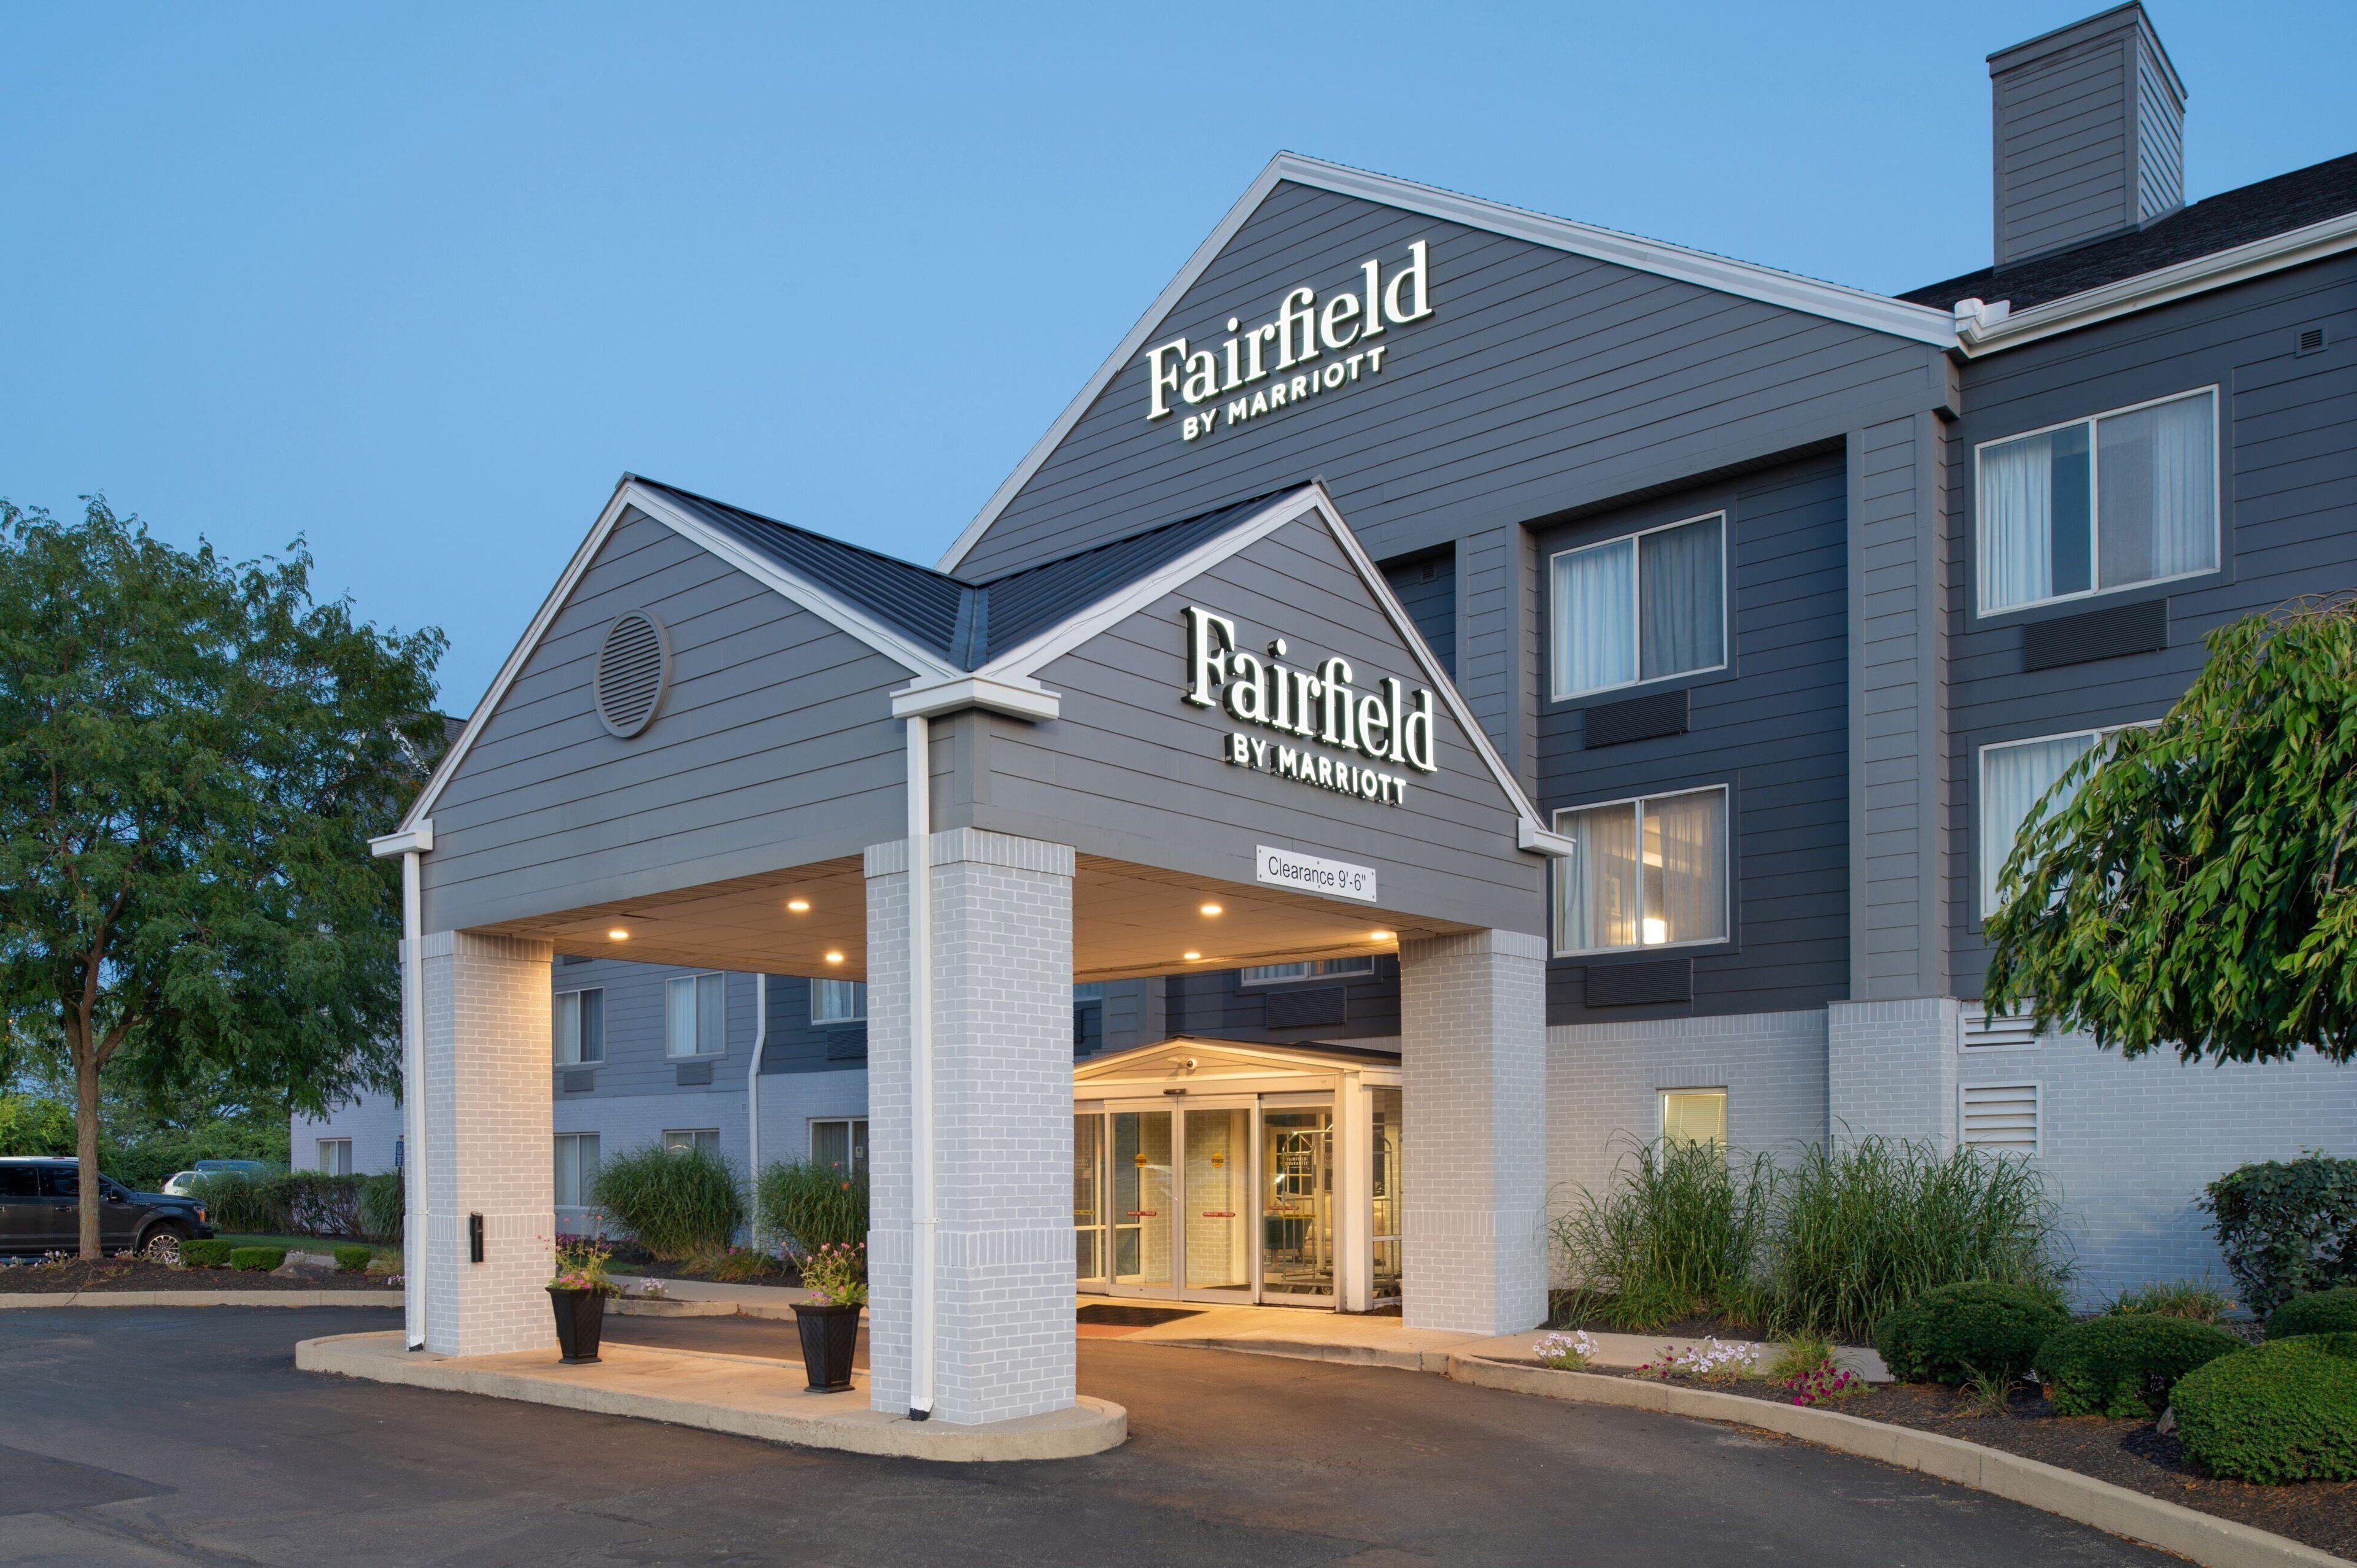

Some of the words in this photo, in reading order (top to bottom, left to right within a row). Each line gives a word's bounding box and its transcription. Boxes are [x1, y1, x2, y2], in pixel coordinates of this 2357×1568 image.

[1145, 240, 1435, 420] Fairfield
[1183, 407, 1220, 442] BY
[1228, 346, 1388, 426] MARRIOTT
[1181, 606, 1438, 773] Fairfield
[1225, 732, 1267, 767] BY
[1271, 744, 1407, 805] MARRIOTT
[1268, 856, 1334, 886] Clearance
